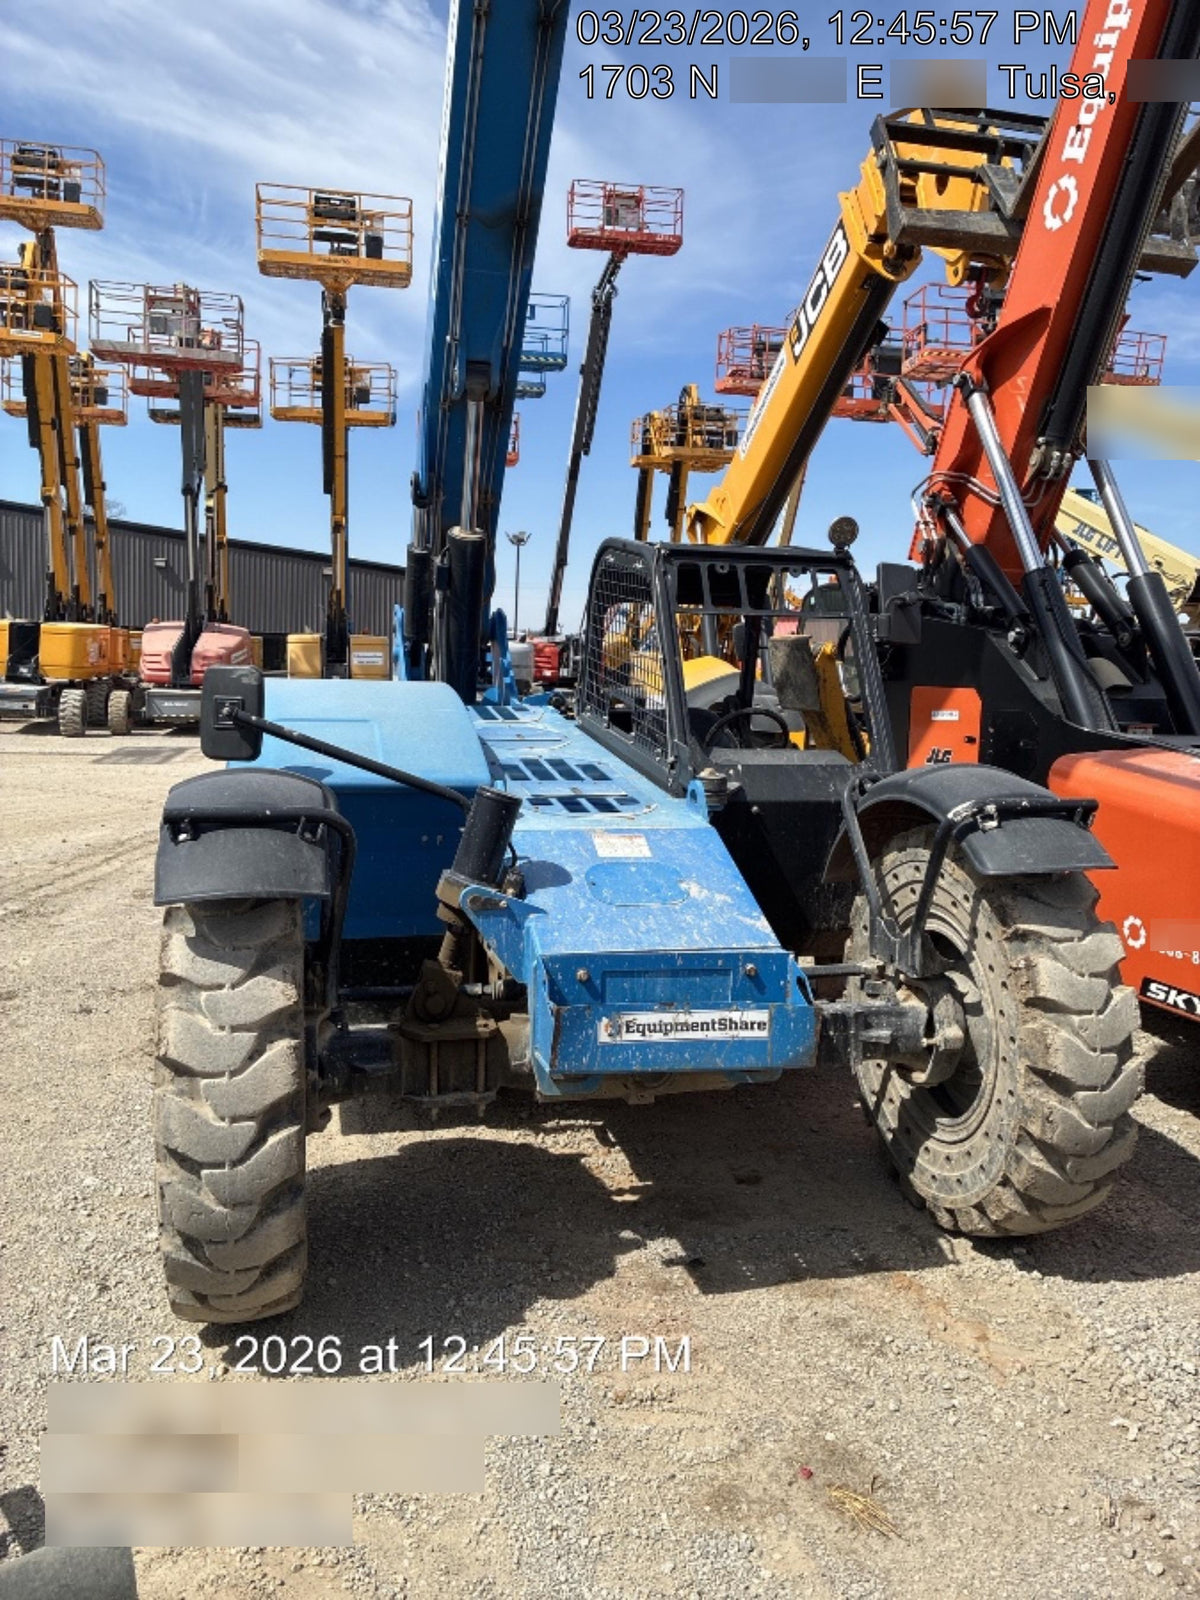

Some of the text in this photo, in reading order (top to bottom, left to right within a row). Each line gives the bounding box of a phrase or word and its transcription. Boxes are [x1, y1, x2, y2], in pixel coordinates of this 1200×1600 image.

[793, 228, 848, 357] JCB
[1071, 520, 1094, 541] JLG
[926, 747, 953, 764] JLG
[625, 1018, 767, 1036] EquipmentShare
